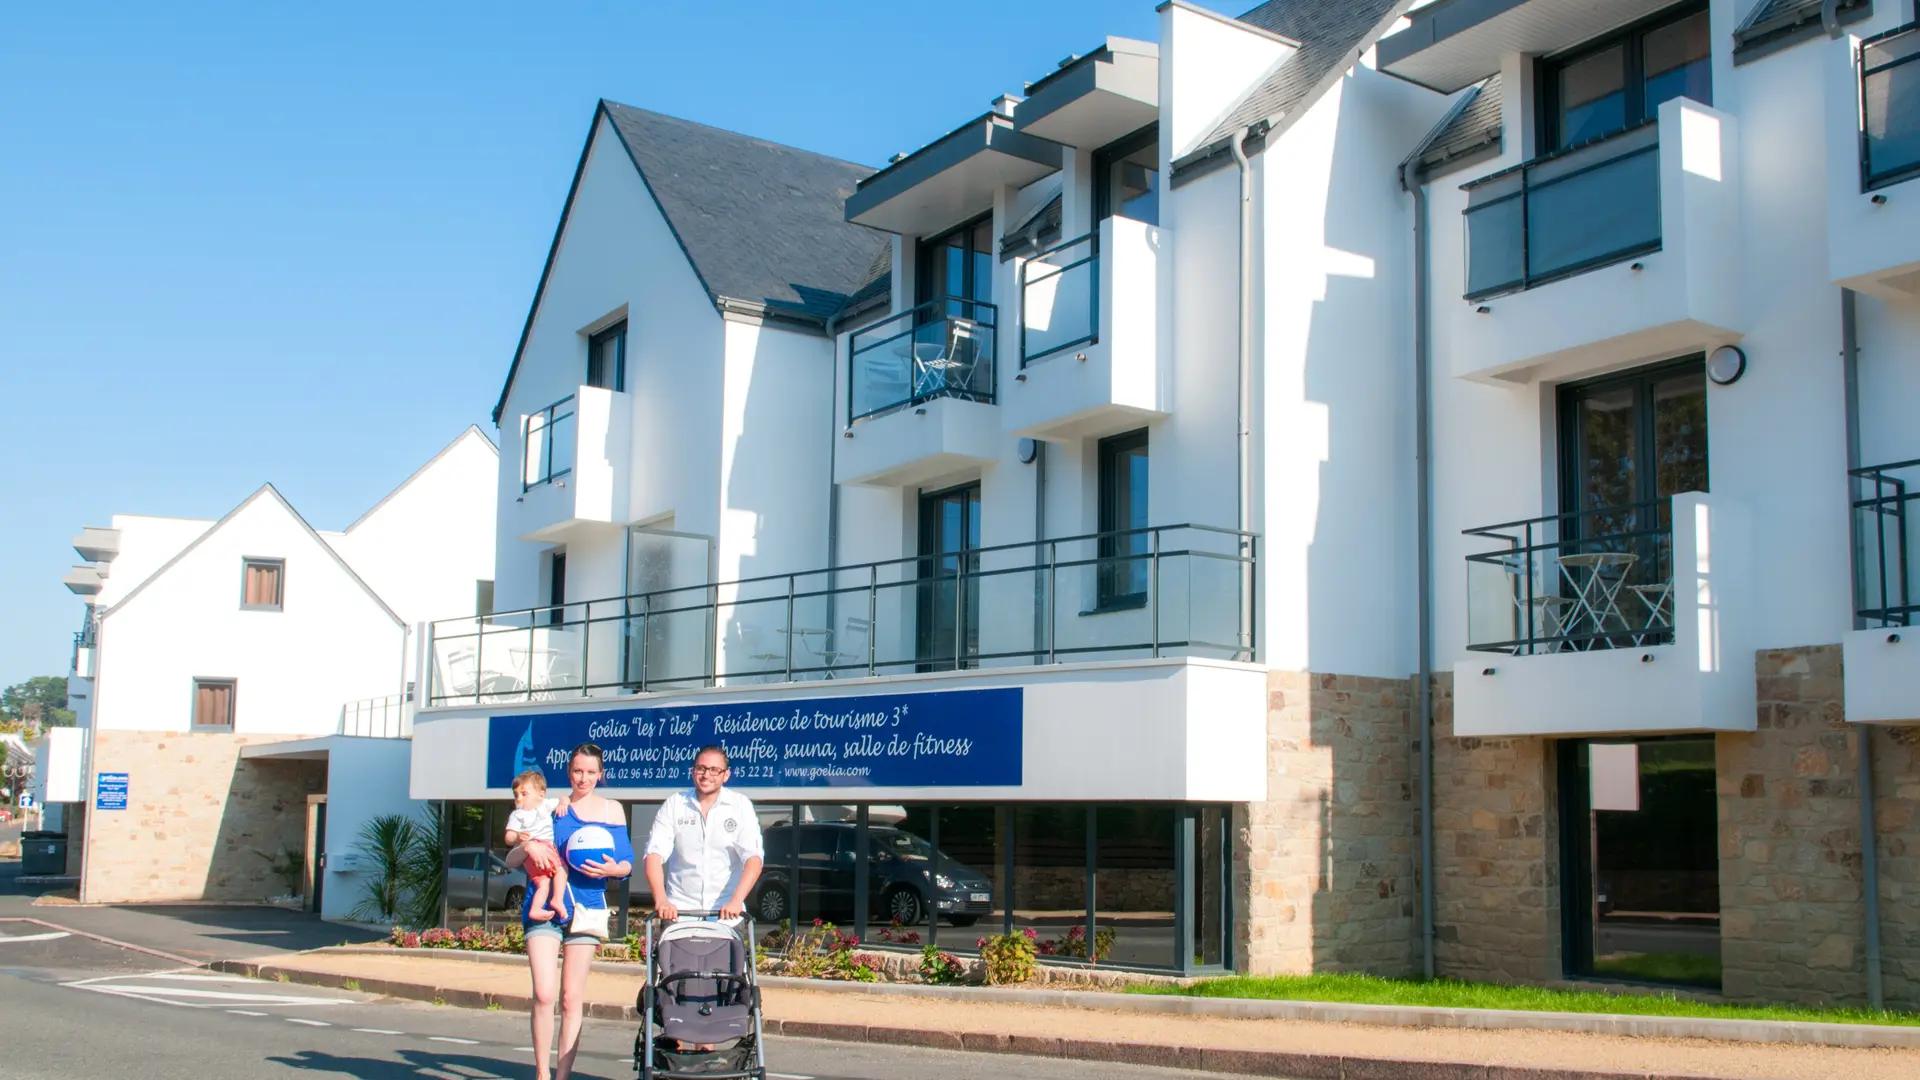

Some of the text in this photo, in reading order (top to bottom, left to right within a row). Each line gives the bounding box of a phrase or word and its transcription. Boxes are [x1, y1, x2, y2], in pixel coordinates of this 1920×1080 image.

[588, 719, 630, 740] Goélia
[658, 718, 666, 736] 7
[713, 711, 788, 735] Résidence
[789, 709, 812, 730] de
[814, 709, 888, 730] tourisme
[630, 745, 661, 762] avec
[662, 743, 700, 767] piscin
[721, 737, 778, 763] hauffée,
[783, 741, 837, 761] sauna,
[843, 734, 885, 759] salle
[887, 734, 911, 756] de
[913, 732, 973, 760] fitness
[618, 768, 629, 779] 02
[631, 768, 641, 778] 96
[643, 767, 653, 778] 45
[656, 767, 666, 778] 20
[668, 767, 679, 778] 20
[734, 766, 746, 778] 45
[748, 766, 760, 777] 22
[762, 765, 774, 777] 21
[784, 763, 871, 780] www.goelia.com
